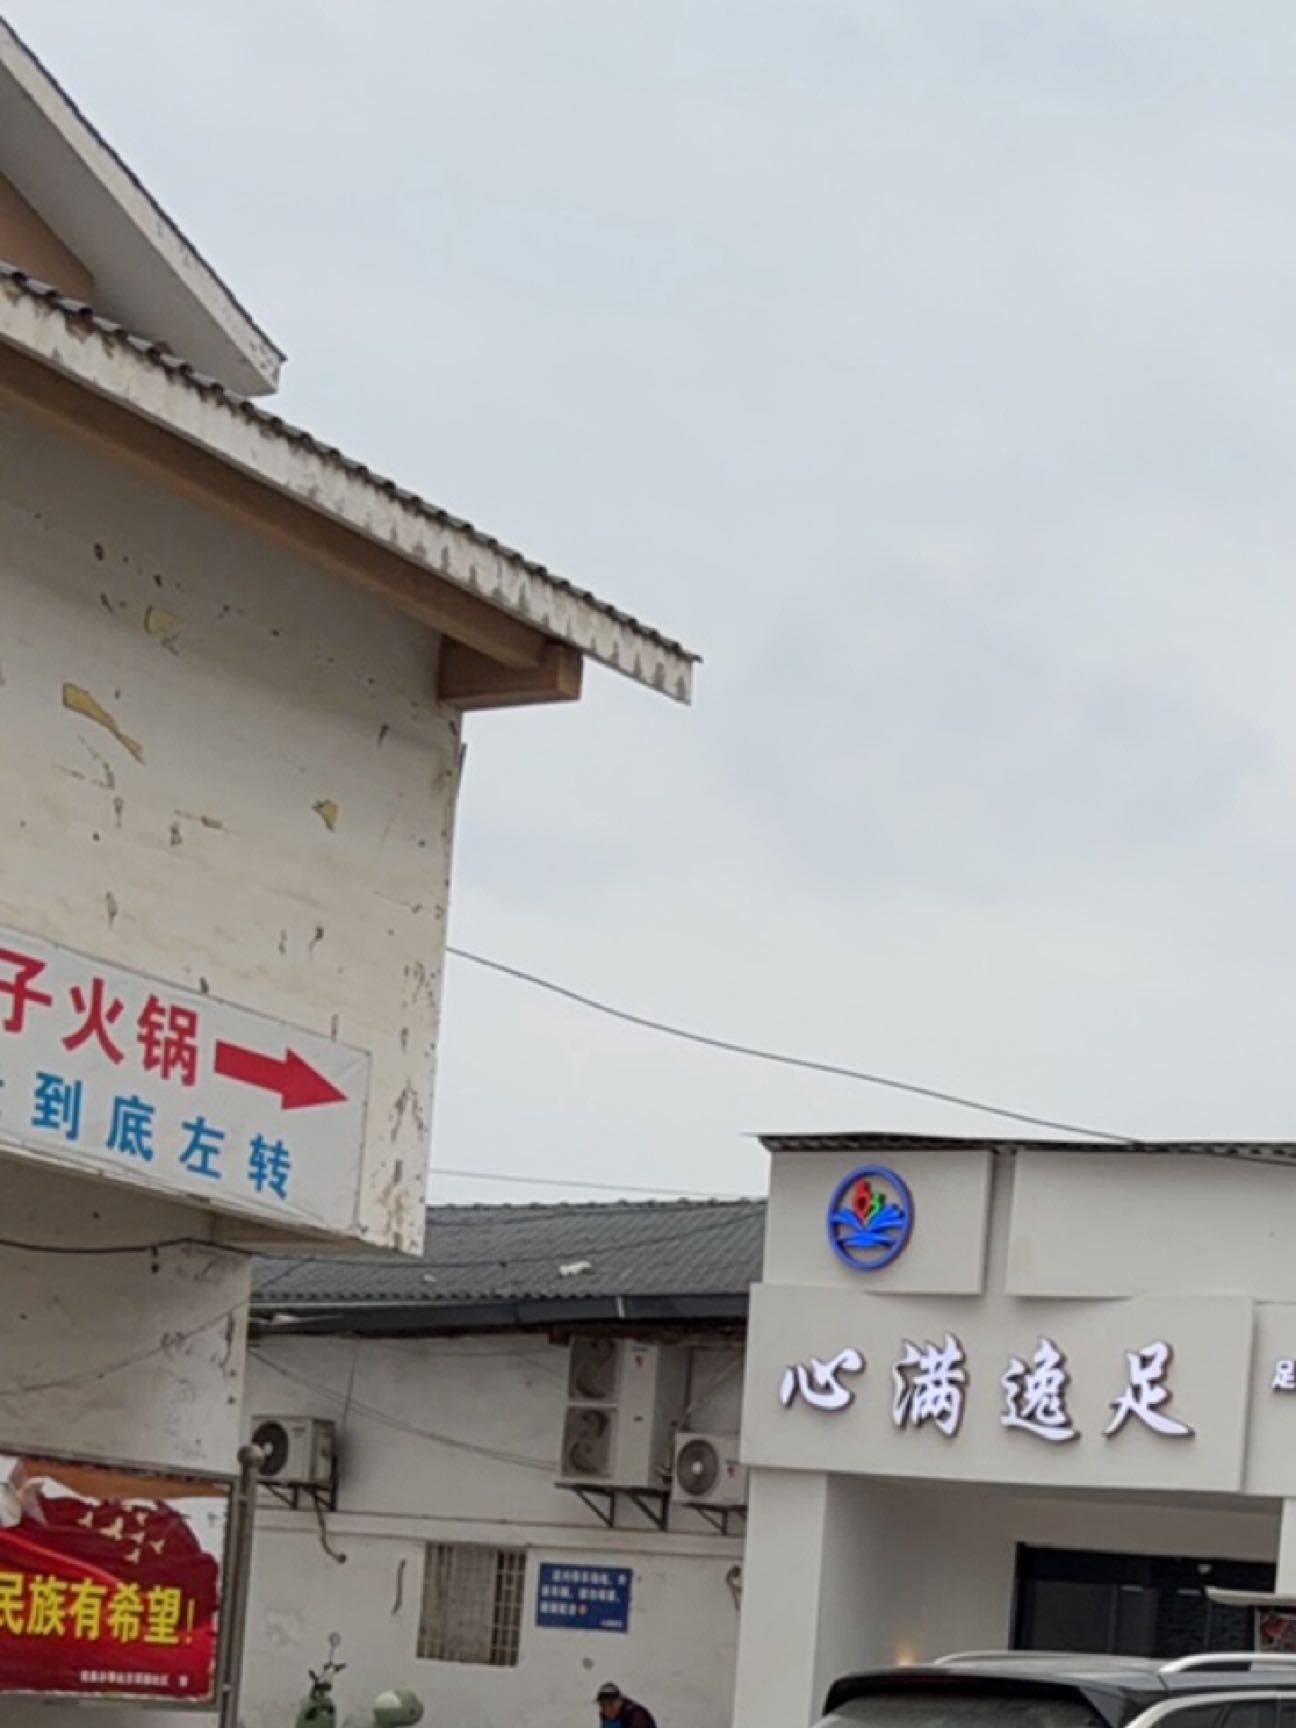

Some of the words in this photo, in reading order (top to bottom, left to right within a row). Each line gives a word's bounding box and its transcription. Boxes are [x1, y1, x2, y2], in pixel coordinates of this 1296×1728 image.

[0, 946, 198, 1087] 子火锅
[31, 1070, 292, 1200] 到底左转
[779, 1333, 1195, 1446] 心满逸足
